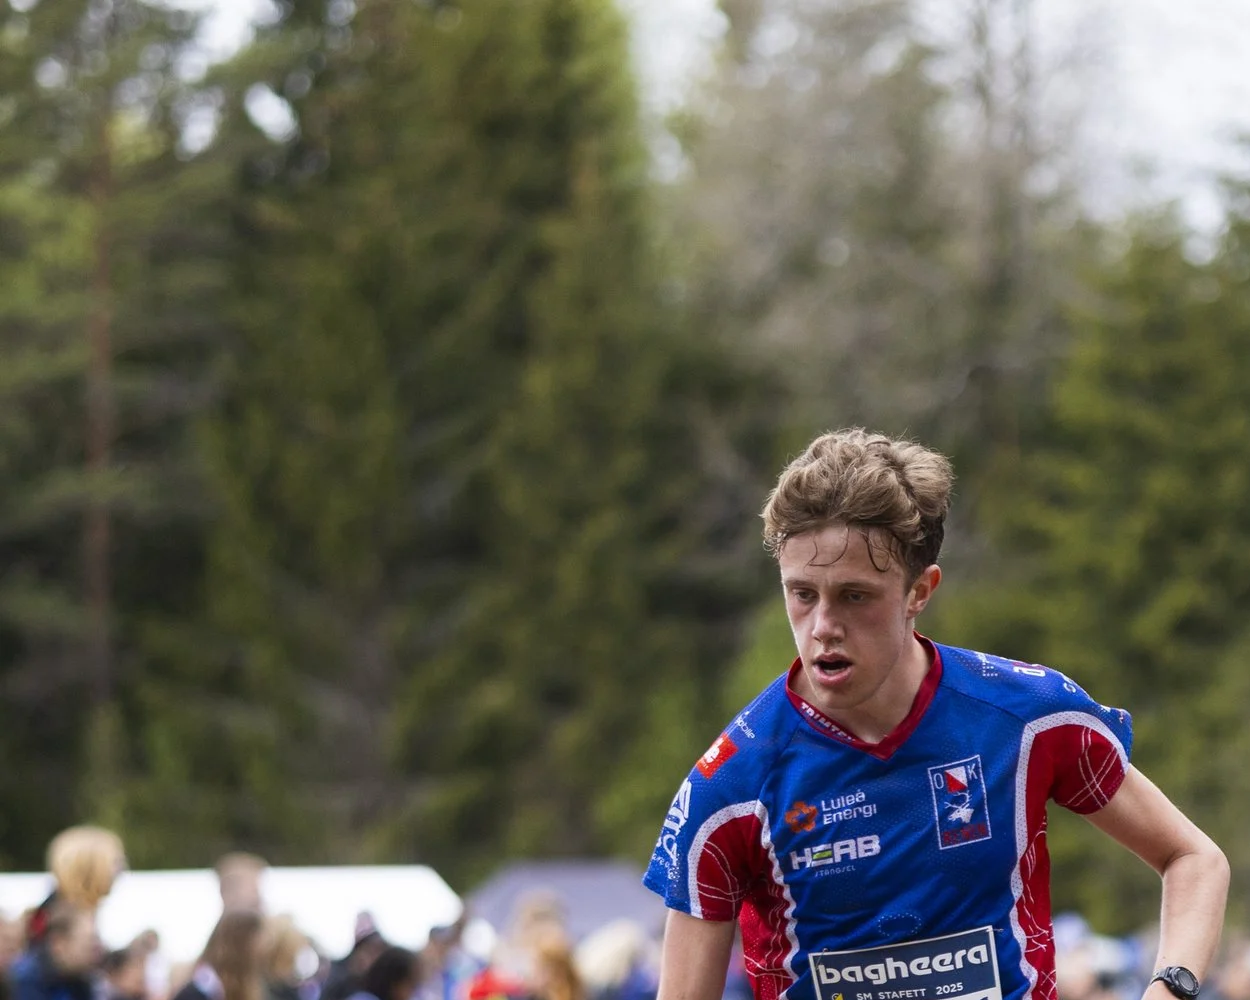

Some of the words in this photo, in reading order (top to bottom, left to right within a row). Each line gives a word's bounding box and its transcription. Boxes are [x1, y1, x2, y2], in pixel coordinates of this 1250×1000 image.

[823, 803, 878, 826] Energi
[819, 944, 989, 985] bagheera
[878, 988, 926, 1000] STAFETT
[935, 982, 964, 996] 2025
